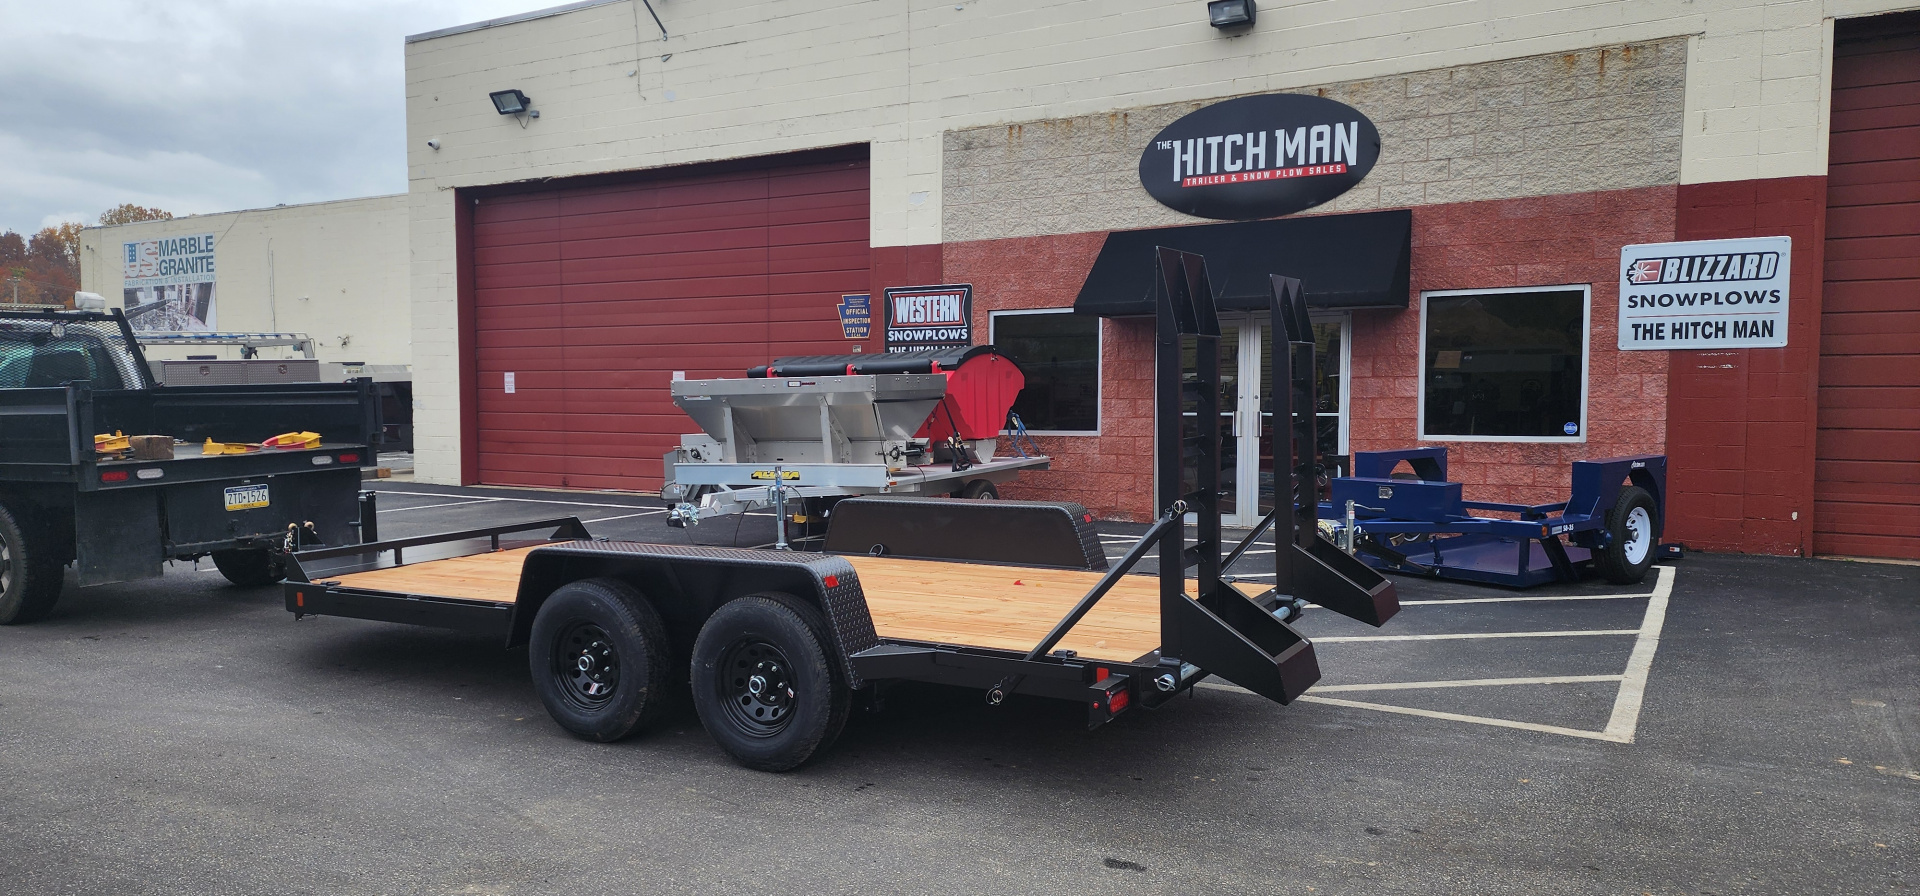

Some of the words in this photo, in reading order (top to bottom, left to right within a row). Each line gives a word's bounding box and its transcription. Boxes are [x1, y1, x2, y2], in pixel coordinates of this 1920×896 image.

[1157, 140, 1172, 150] THE
[1173, 131, 1266, 182] HITCH
[1275, 121, 1358, 167] MAN
[1187, 175, 1225, 186] TRAILER
[1231, 174, 1237, 182] &
[1243, 171, 1271, 180] SNOW
[1276, 168, 1303, 178] PLOW
[1309, 164, 1342, 175] SALES
[158, 235, 214, 257] MARBLE
[124, 241, 159, 278] US
[159, 255, 215, 276] GRANITE
[1662, 252, 1778, 283] BLIZZARD
[124, 278, 163, 287] FABRICATION
[170, 274, 215, 283] INSTALLATION
[895, 295, 960, 324] WESTERN
[1627, 289, 1781, 309] SNOWPLOWS
[843, 317, 871, 325] INSPECTION
[845, 308, 869, 316] OFFICIAL
[846, 326, 868, 334] STATION
[888, 328, 968, 342] SNOWPLOWS
[1632, 323, 1666, 341] THE
[1671, 321, 1727, 340] HITCH
[1733, 319, 1775, 338] MAN
